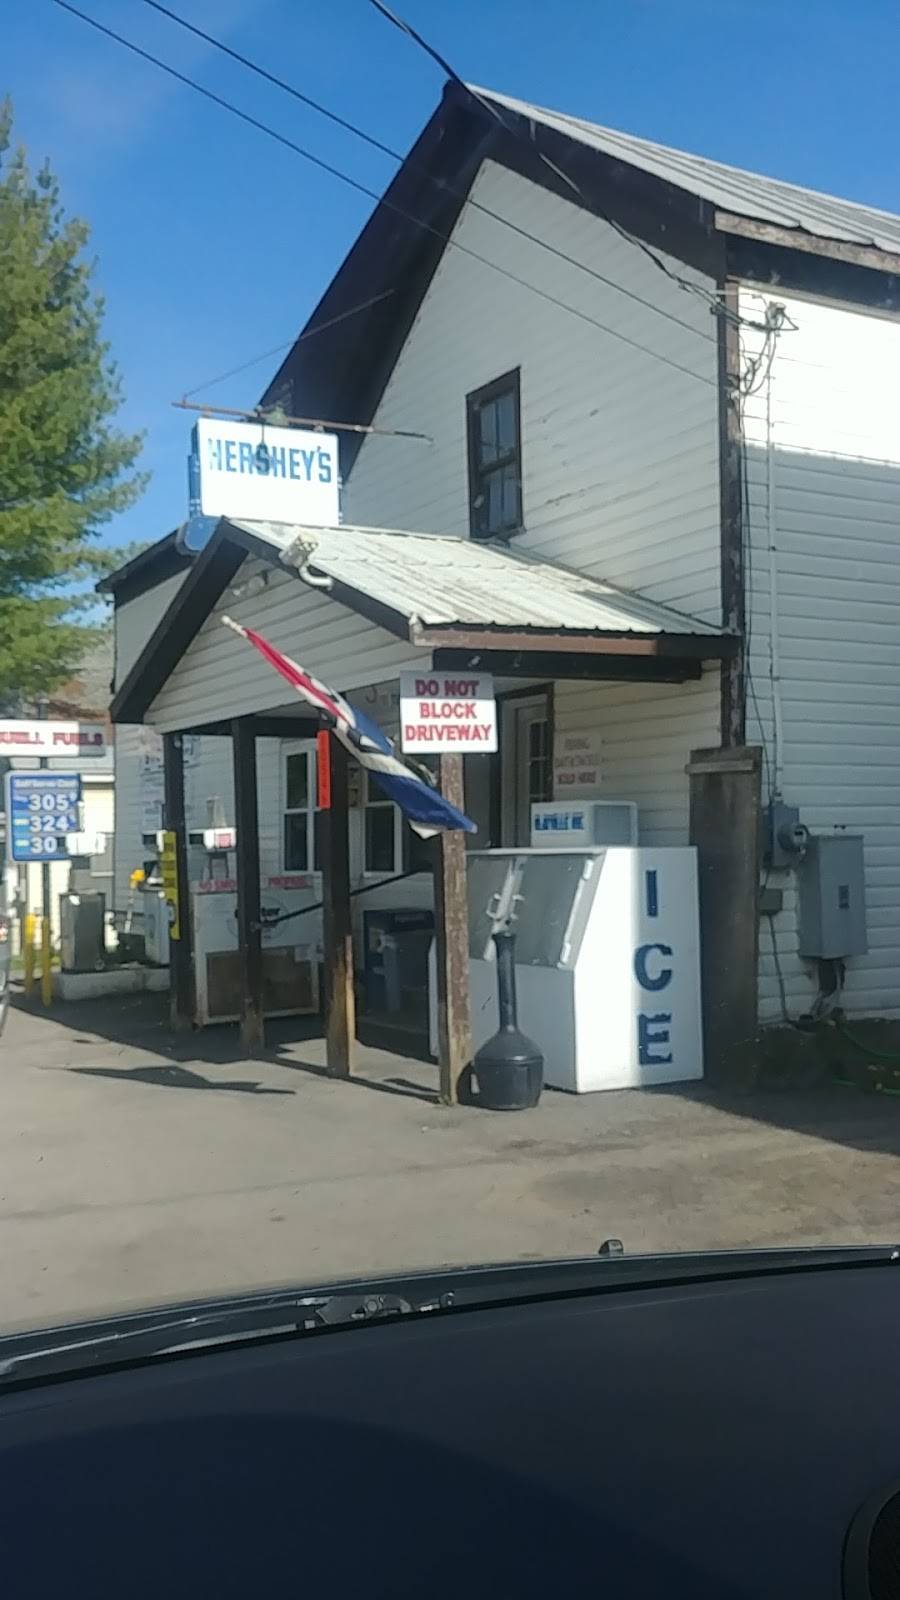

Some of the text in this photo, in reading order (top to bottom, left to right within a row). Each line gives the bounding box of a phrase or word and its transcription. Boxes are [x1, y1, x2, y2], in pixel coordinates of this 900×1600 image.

[208, 437, 332, 483] HERSHEY'S
[415, 679, 439, 696] DO
[444, 679, 480, 697] NOT
[419, 702, 477, 719] BLOCK
[53, 732, 103, 746] FUELS
[404, 723, 492, 741] DRIVEWAY
[29, 793, 69, 811] 305
[634, 869, 674, 1066] ICE
